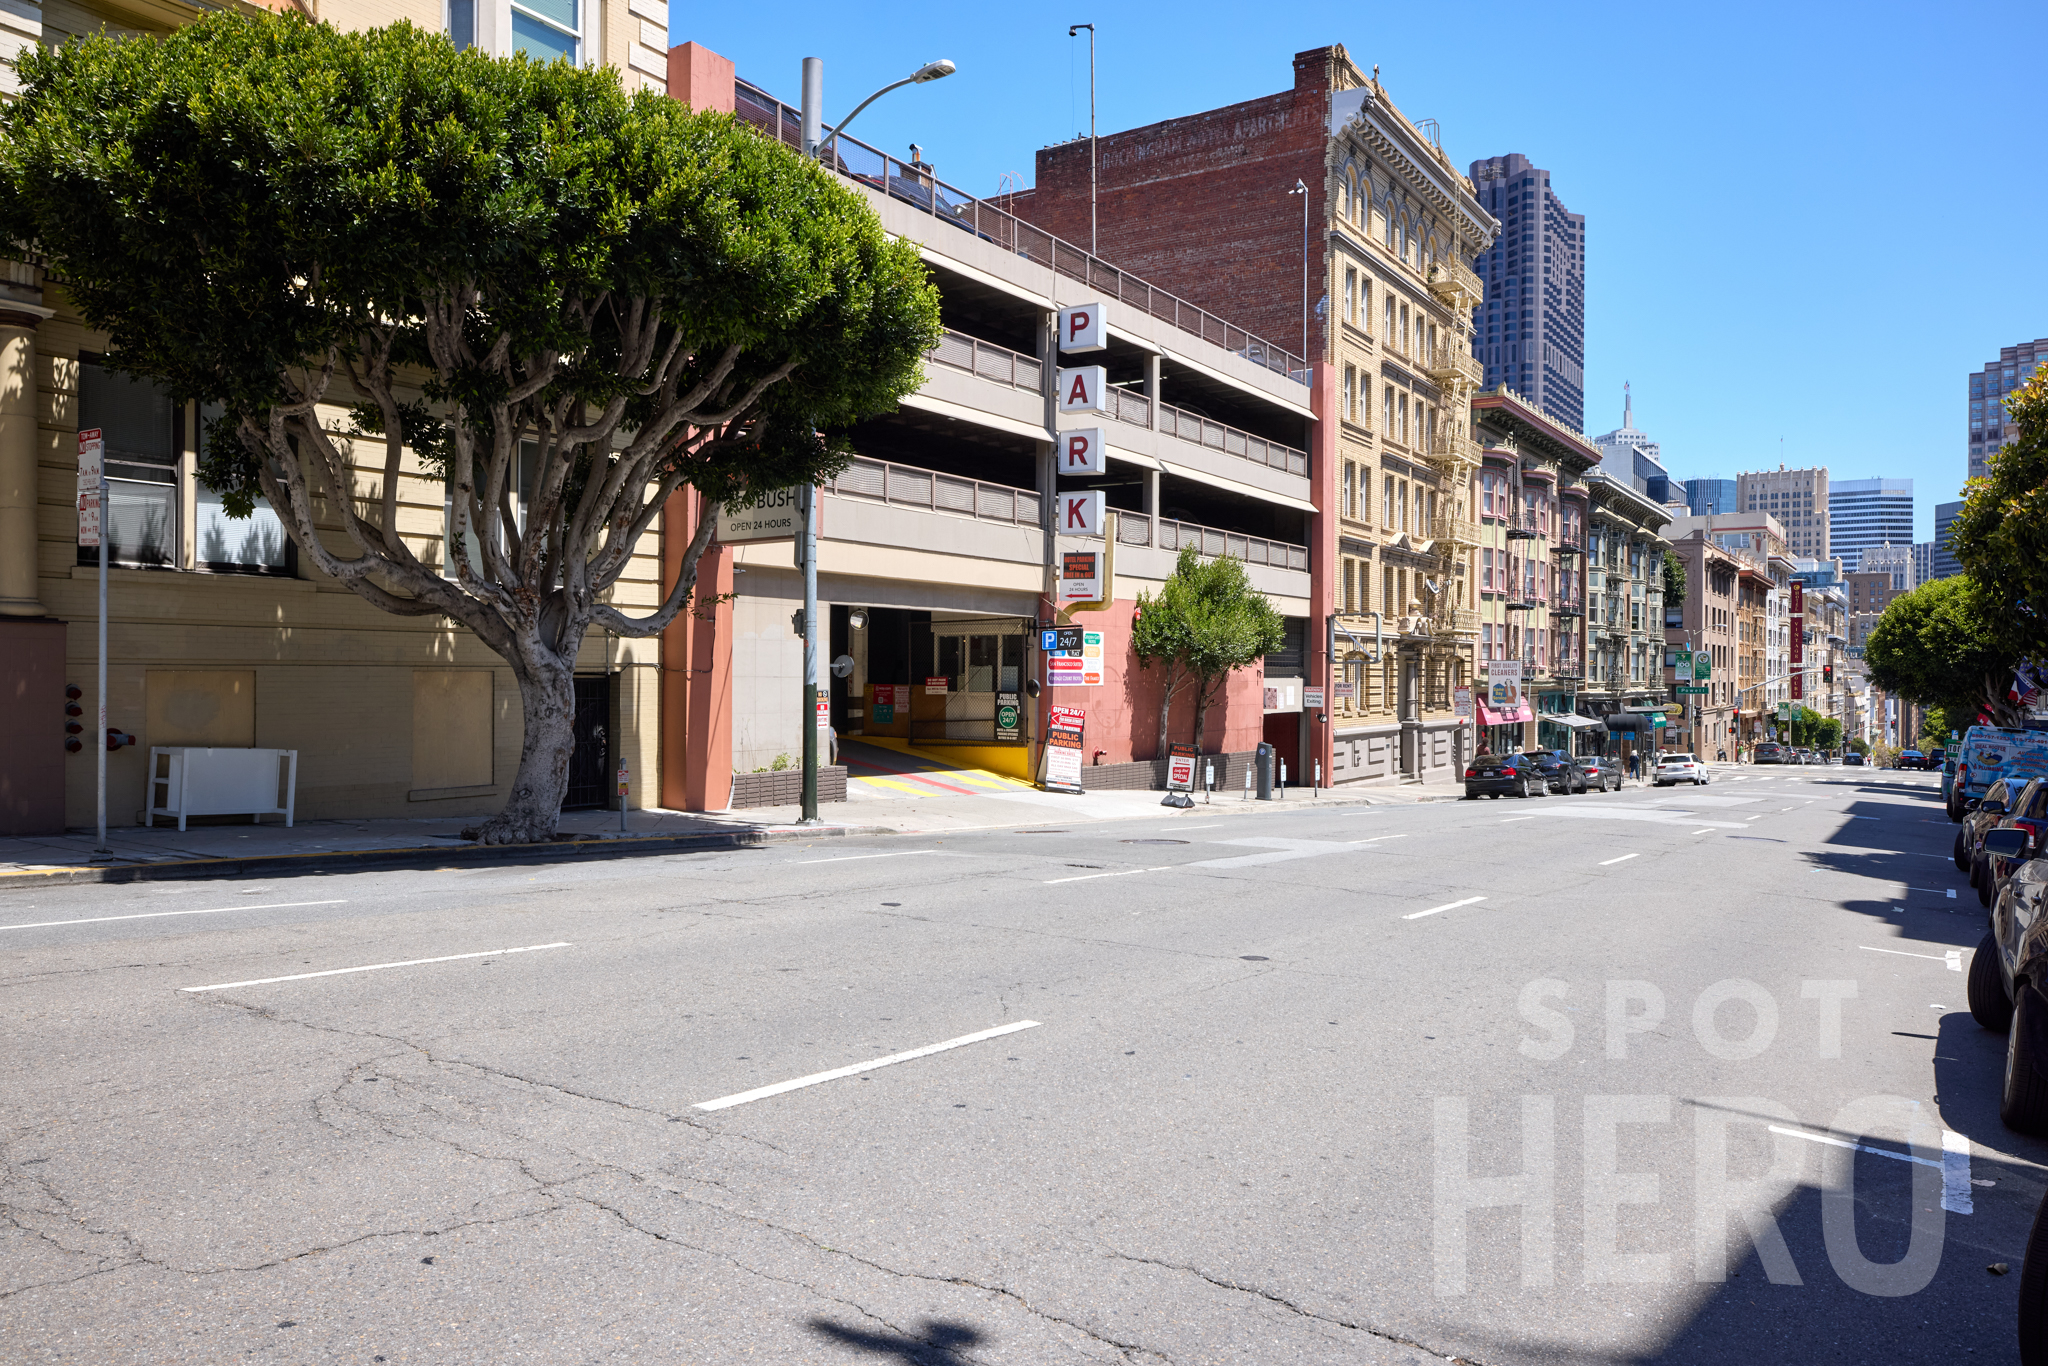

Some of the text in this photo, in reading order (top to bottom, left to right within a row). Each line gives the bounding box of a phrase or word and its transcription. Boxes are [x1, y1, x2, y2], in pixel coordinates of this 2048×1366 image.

[1067, 311, 1090, 529] PARK
[80, 431, 100, 440] TOW-AWAY
[80, 441, 101, 454] NO STOPPING
[80, 495, 86, 510] NO
[757, 490, 796, 510] BUSH
[730, 518, 792, 532] OPEN 24 HOURS
[1060, 637, 1077, 647] 24/7
[1053, 706, 1069, 714] OPEN
[1053, 731, 1079, 741] PUBLIC
[1050, 738, 1081, 748] PARKING
